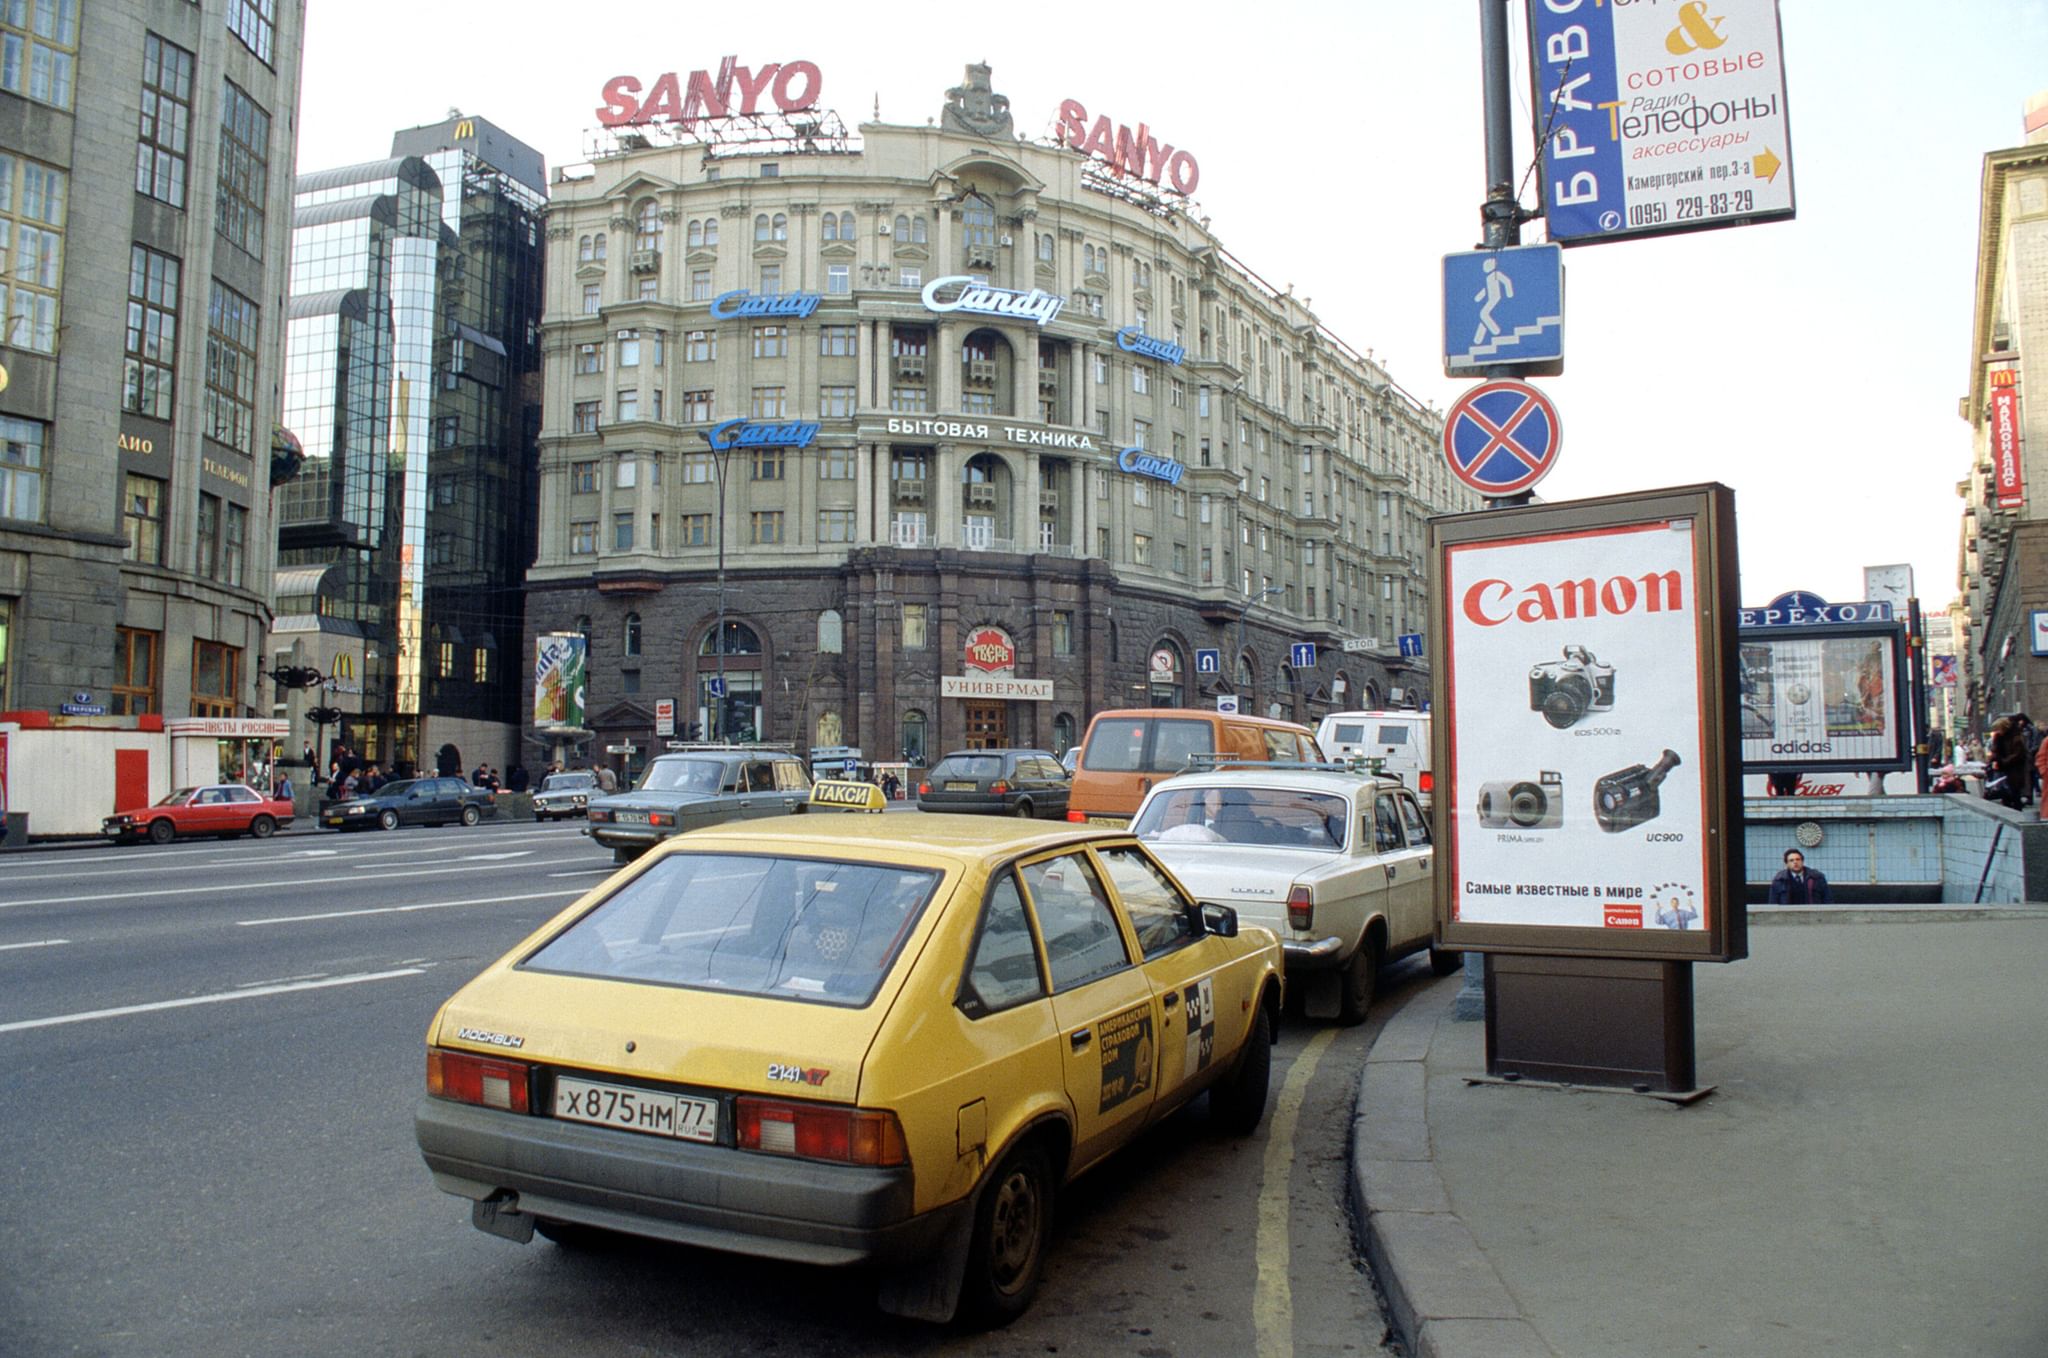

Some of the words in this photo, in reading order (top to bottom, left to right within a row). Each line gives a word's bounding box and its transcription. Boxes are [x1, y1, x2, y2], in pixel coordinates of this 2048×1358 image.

[1665, 1, 1728, 56] &
[1627, 51, 1764, 89] сотовые
[595, 55, 822, 131] SANYO
[1631, 92, 1690, 113] Радио
[1597, 94, 1777, 141] Телефоны
[1056, 98, 1199, 195] SANYO
[1632, 131, 1749, 159] аксессуары
[1627, 167, 1703, 191] Камергерский
[1630, 202, 1667, 226] (095)
[1676, 190, 1753, 219] 229-83-29
[710, 288, 822, 320] Candy
[921, 275, 1066, 325] Candy
[1117, 326, 1185, 366] Candy
[708, 417, 822, 449] Candy
[888, 418, 988, 439] БЫТОВАЯ
[1004, 427, 1092, 449] ТЕХНИКА
[203, 457, 249, 488] ТЕЛЕФОН
[1119, 447, 1185, 486] Candy
[1463, 570, 1683, 627] Canon
[1739, 604, 1882, 626] ЕРЕХОД
[972, 643, 1009, 663] ТВЕРЬ
[1347, 639, 1373, 649] СТОП
[947, 680, 1050, 696] УНИВЕРМАГ
[205, 722, 236, 734] ЦВЕТЫ
[241, 722, 275, 734] РОССИИ
[1771, 740, 1832, 754] adidas
[817, 784, 868, 804] ТАКСИ
[1646, 833, 1684, 843] UC900
[1466, 881, 1511, 895] Самые
[1516, 884, 1589, 897] известные
[1594, 886, 1601, 897] в
[1606, 886, 1642, 900] мире
[1607, 915, 1639, 926] Canon
[458, 1027, 524, 1048] МОСКВИЧ
[768, 1063, 801, 1082] 2141
[680, 1100, 706, 1126] 77
[677, 1124, 697, 1135] RUS
